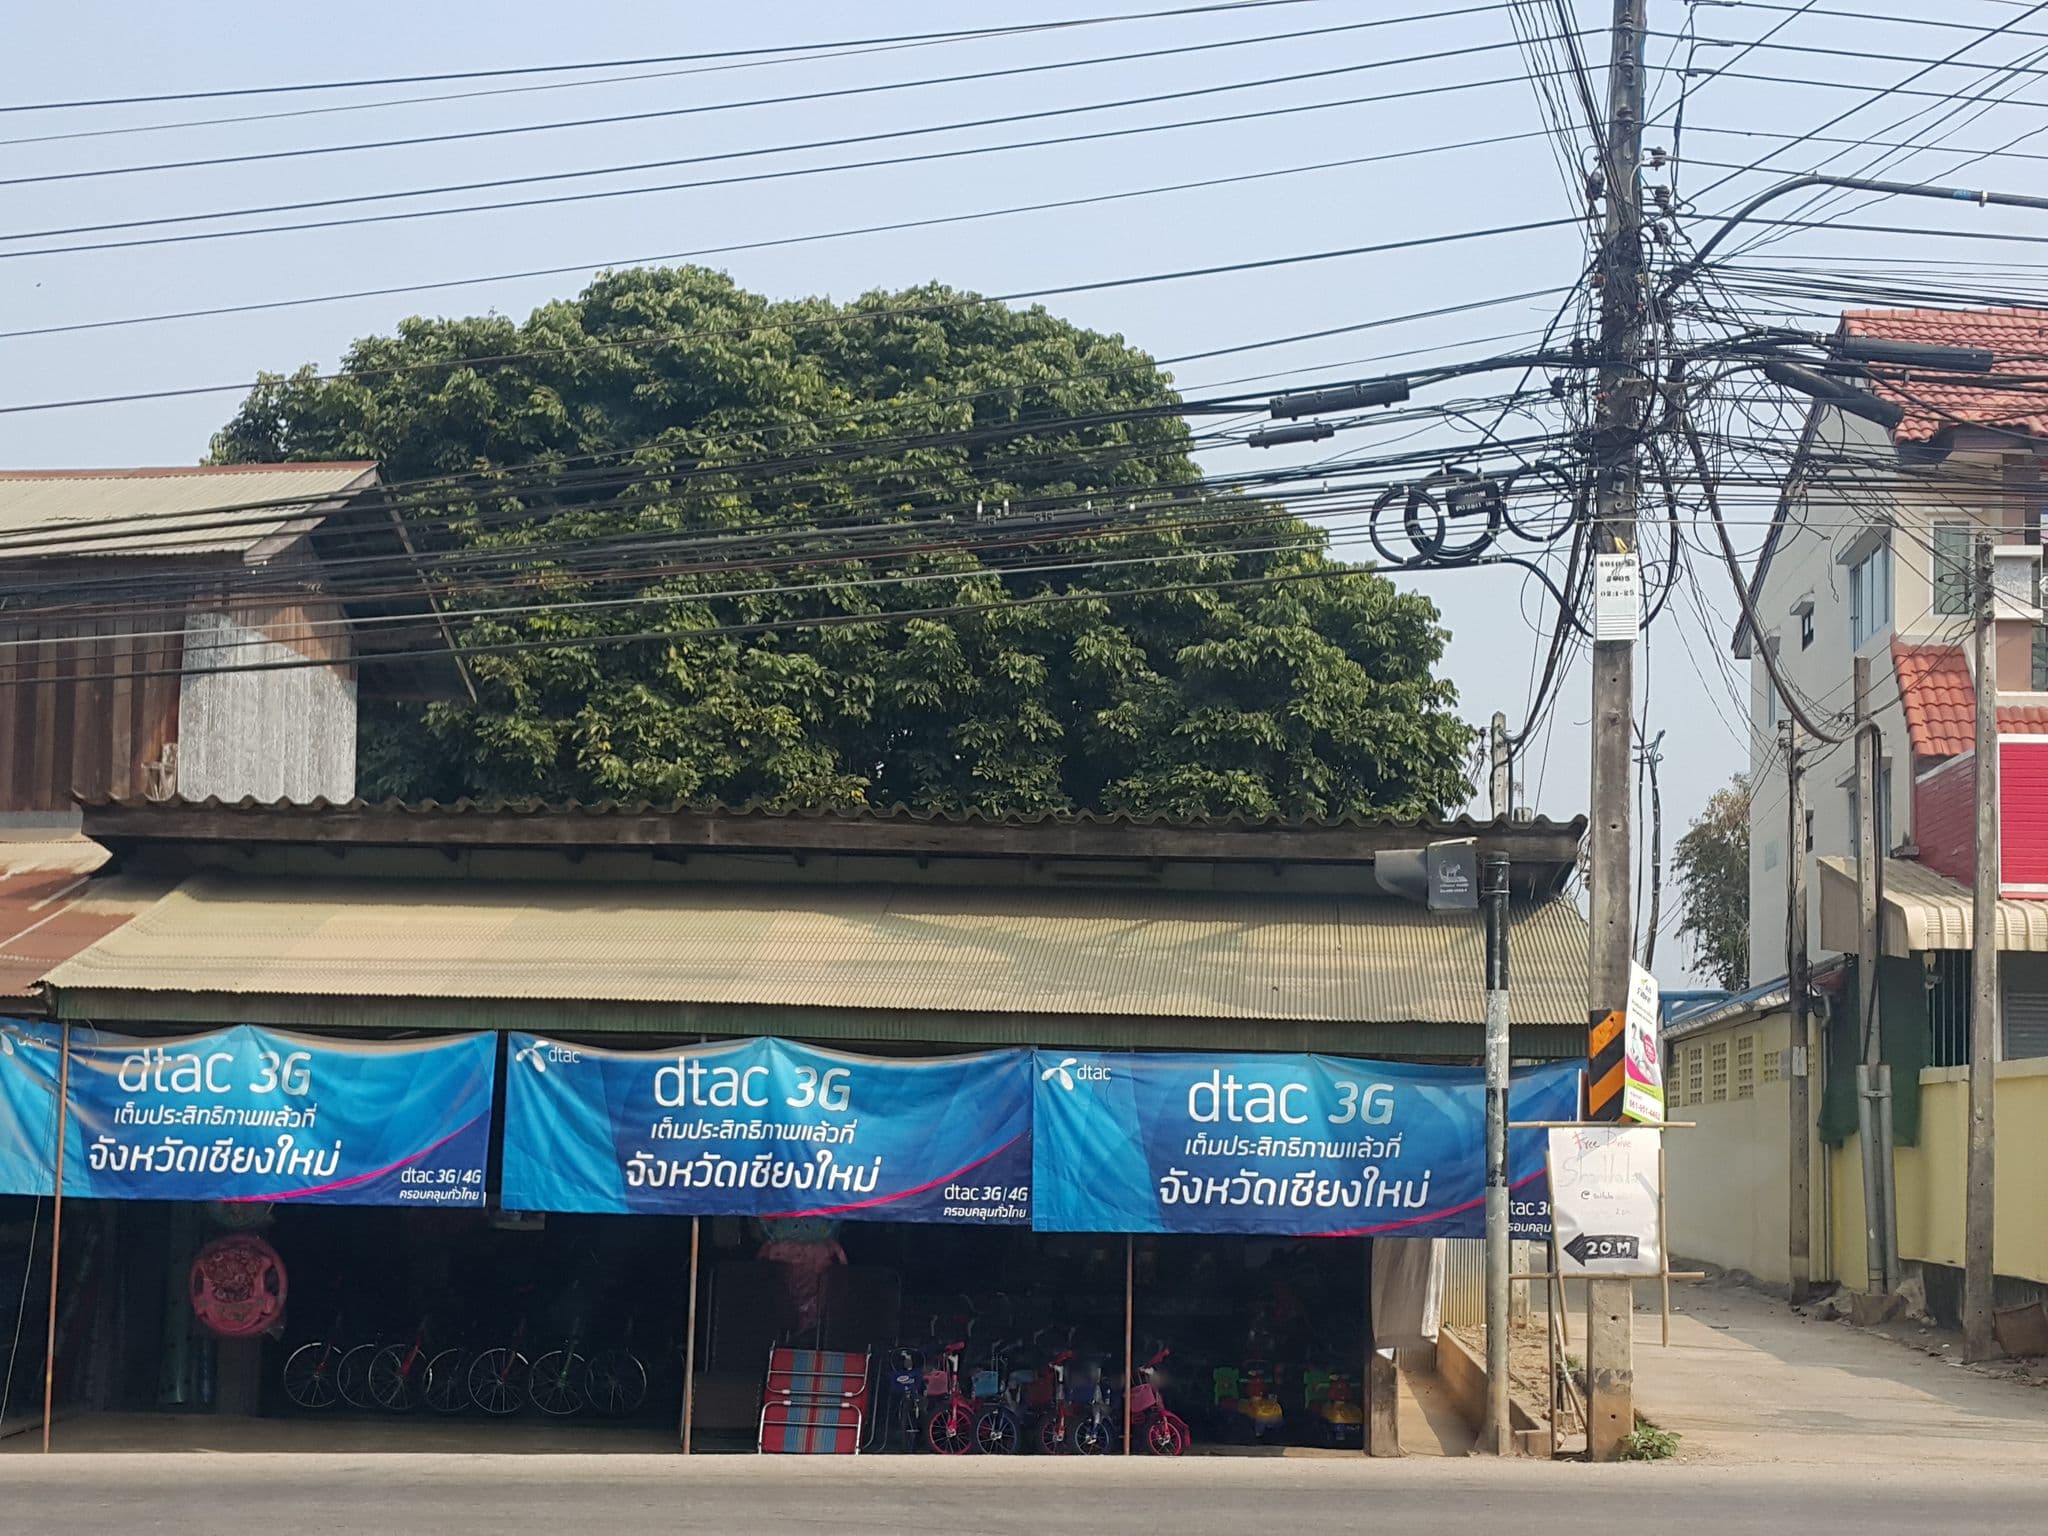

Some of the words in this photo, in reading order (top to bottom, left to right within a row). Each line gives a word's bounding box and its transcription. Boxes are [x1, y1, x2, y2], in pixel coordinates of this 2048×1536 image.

[548, 1046, 581, 1063] dtac
[118, 1047, 233, 1093] dtac
[249, 1051, 312, 1096] 3G
[654, 1056, 769, 1107] dtac
[786, 1066, 852, 1112] 3G
[1077, 1063, 1112, 1080] dtac
[1187, 1068, 1308, 1124] dtac
[1328, 1081, 1395, 1125] 3G
[114, 1101, 318, 1128] เต็มประสิทธิภาพแล้วที่
[651, 1116, 858, 1144] เต็มประสิทธิภาพแล้วที่
[89, 1134, 342, 1176] จังหวัดเชียงใหม่
[1185, 1132, 1403, 1159] เต็มประสิทธิภาพแล้วที่
[401, 1166, 434, 1184] dtac
[626, 1149, 883, 1192] จังหวัดเชียงใหม่
[399, 1185, 480, 1203] ครอบคลุมทั่วไทย
[944, 1183, 979, 1200] dtac
[1159, 1165, 1431, 1208] จังหวัดเชียงใหม่
[943, 1203, 1027, 1221] ครอบคลุมทั่วไทย
[1510, 1200, 1535, 1216] tac
[1508, 1222, 1552, 1236] รอบคลุม
